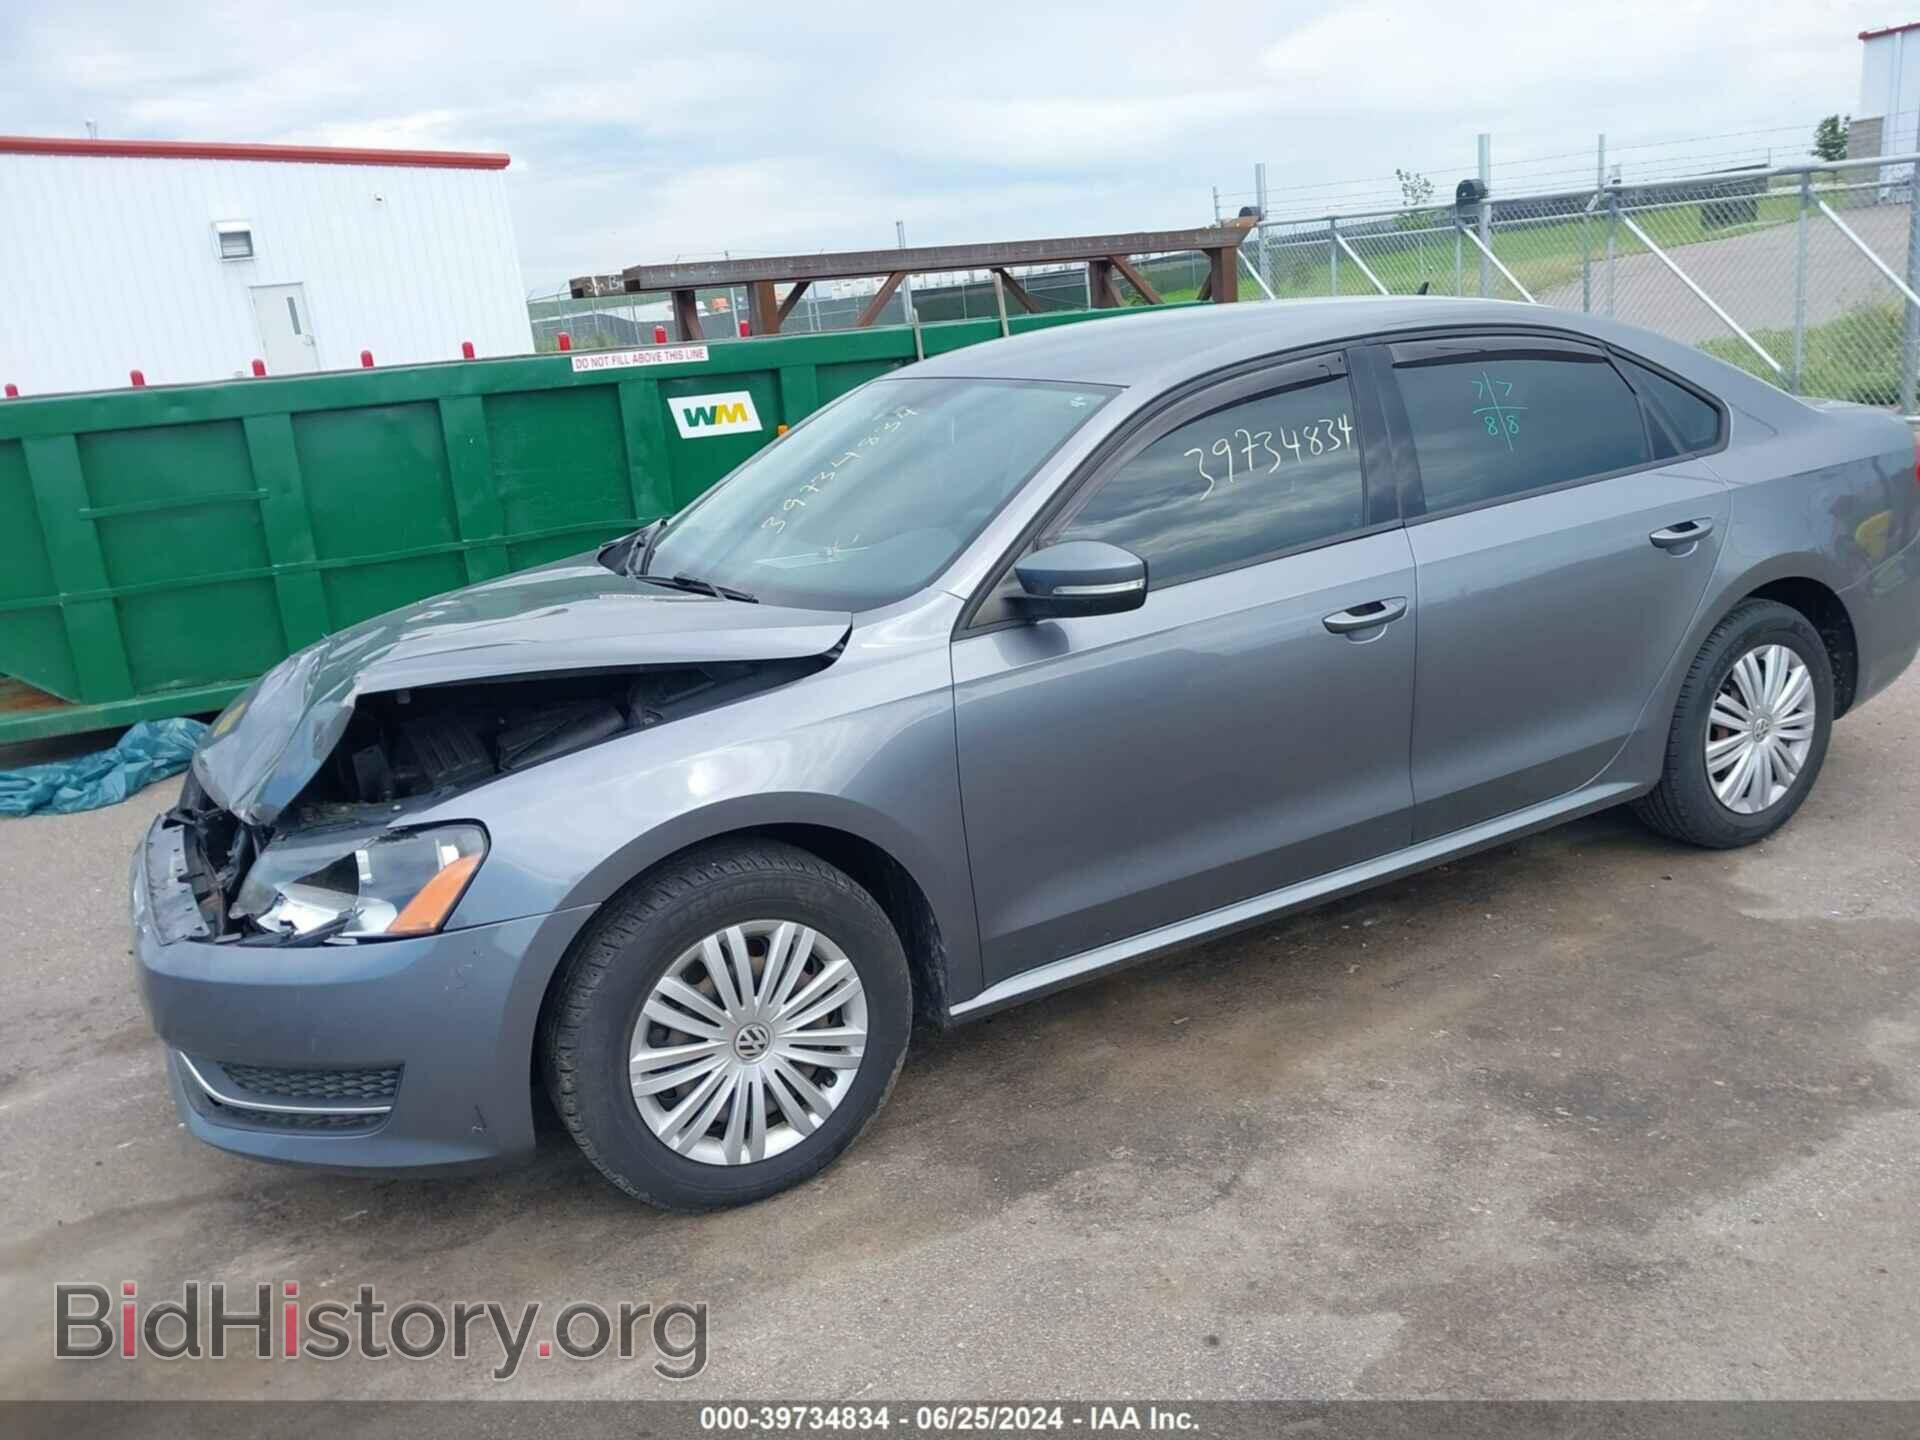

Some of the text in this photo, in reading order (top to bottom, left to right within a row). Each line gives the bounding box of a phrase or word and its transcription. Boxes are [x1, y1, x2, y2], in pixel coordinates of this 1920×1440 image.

[575, 348, 705, 369] DO NOT FILL ABOVE THIS LINE
[683, 403, 749, 427] WM
[1484, 414, 1520, 435] 8 8
[1184, 414, 1354, 502] 39734834
